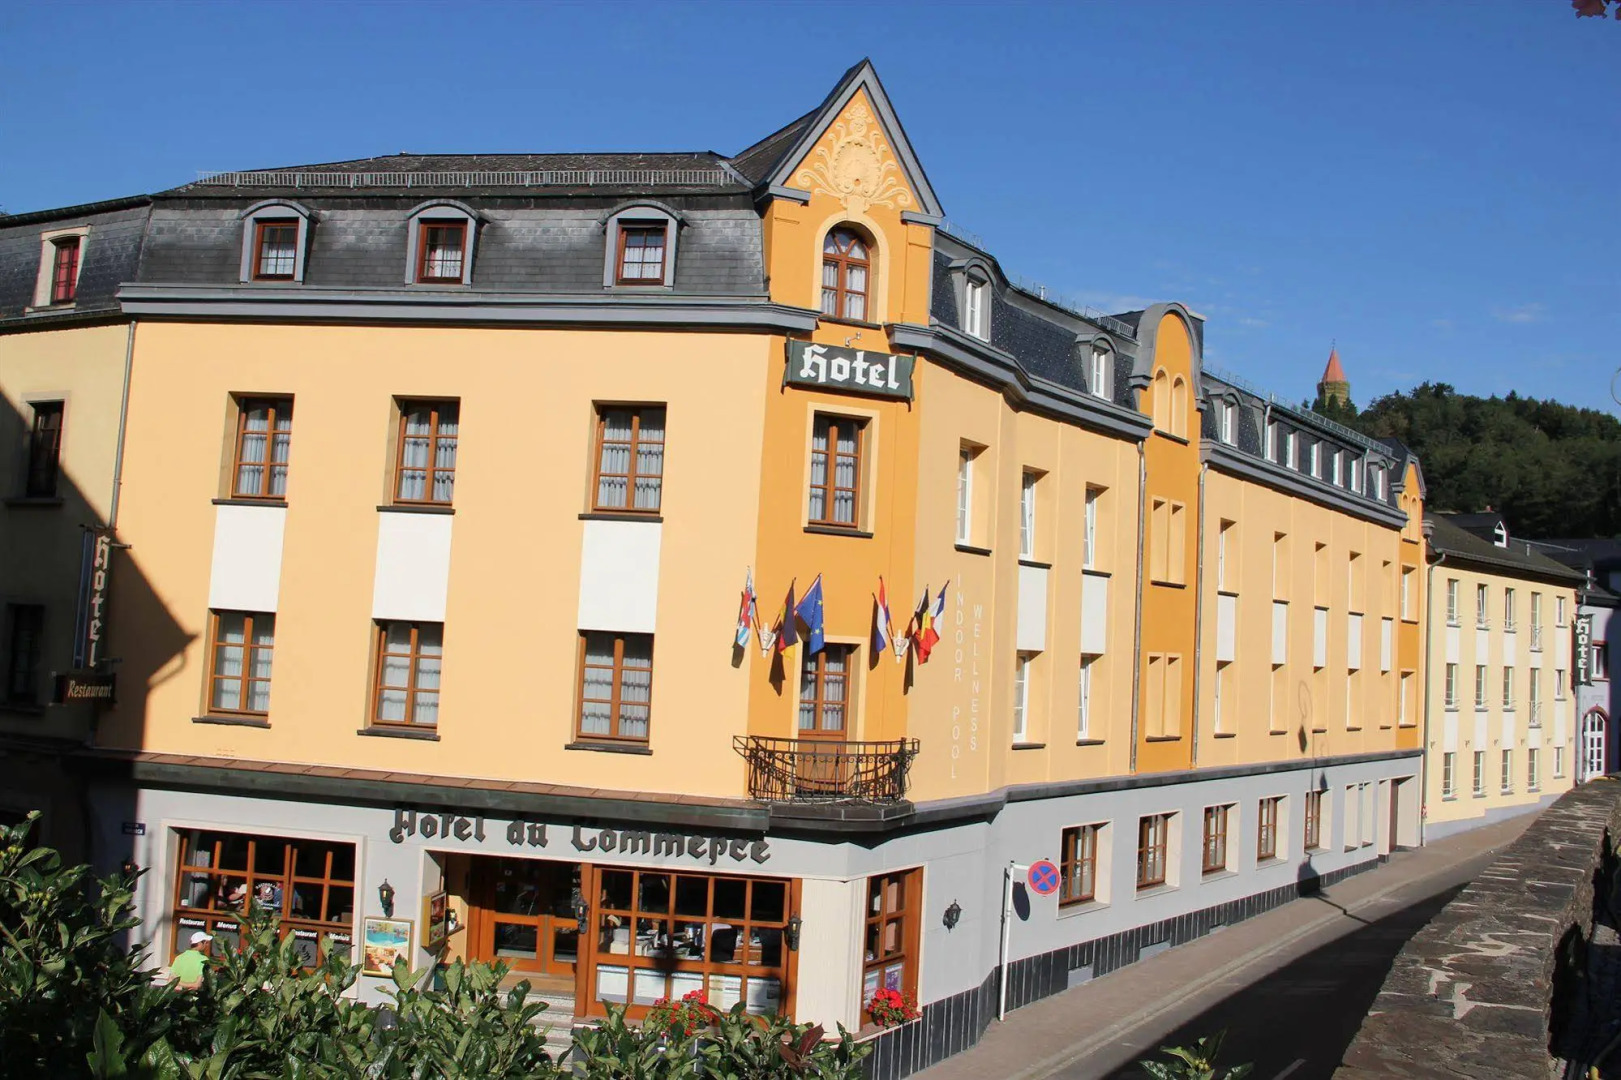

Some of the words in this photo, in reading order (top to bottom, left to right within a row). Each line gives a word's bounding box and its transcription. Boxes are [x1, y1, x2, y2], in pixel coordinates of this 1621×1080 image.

[800, 343, 900, 390] Hotel
[89, 534, 111, 668] Hotel
[954, 573, 964, 681] INDOOR
[970, 604, 982, 751] WELLNESS
[1575, 617, 1590, 682] Hotel
[67, 679, 112, 699] Restaurant
[951, 706, 960, 779] POOL
[389, 807, 486, 844] Hotel
[179, 917, 206, 927] Restaurant
[216, 921, 238, 930] Menus
